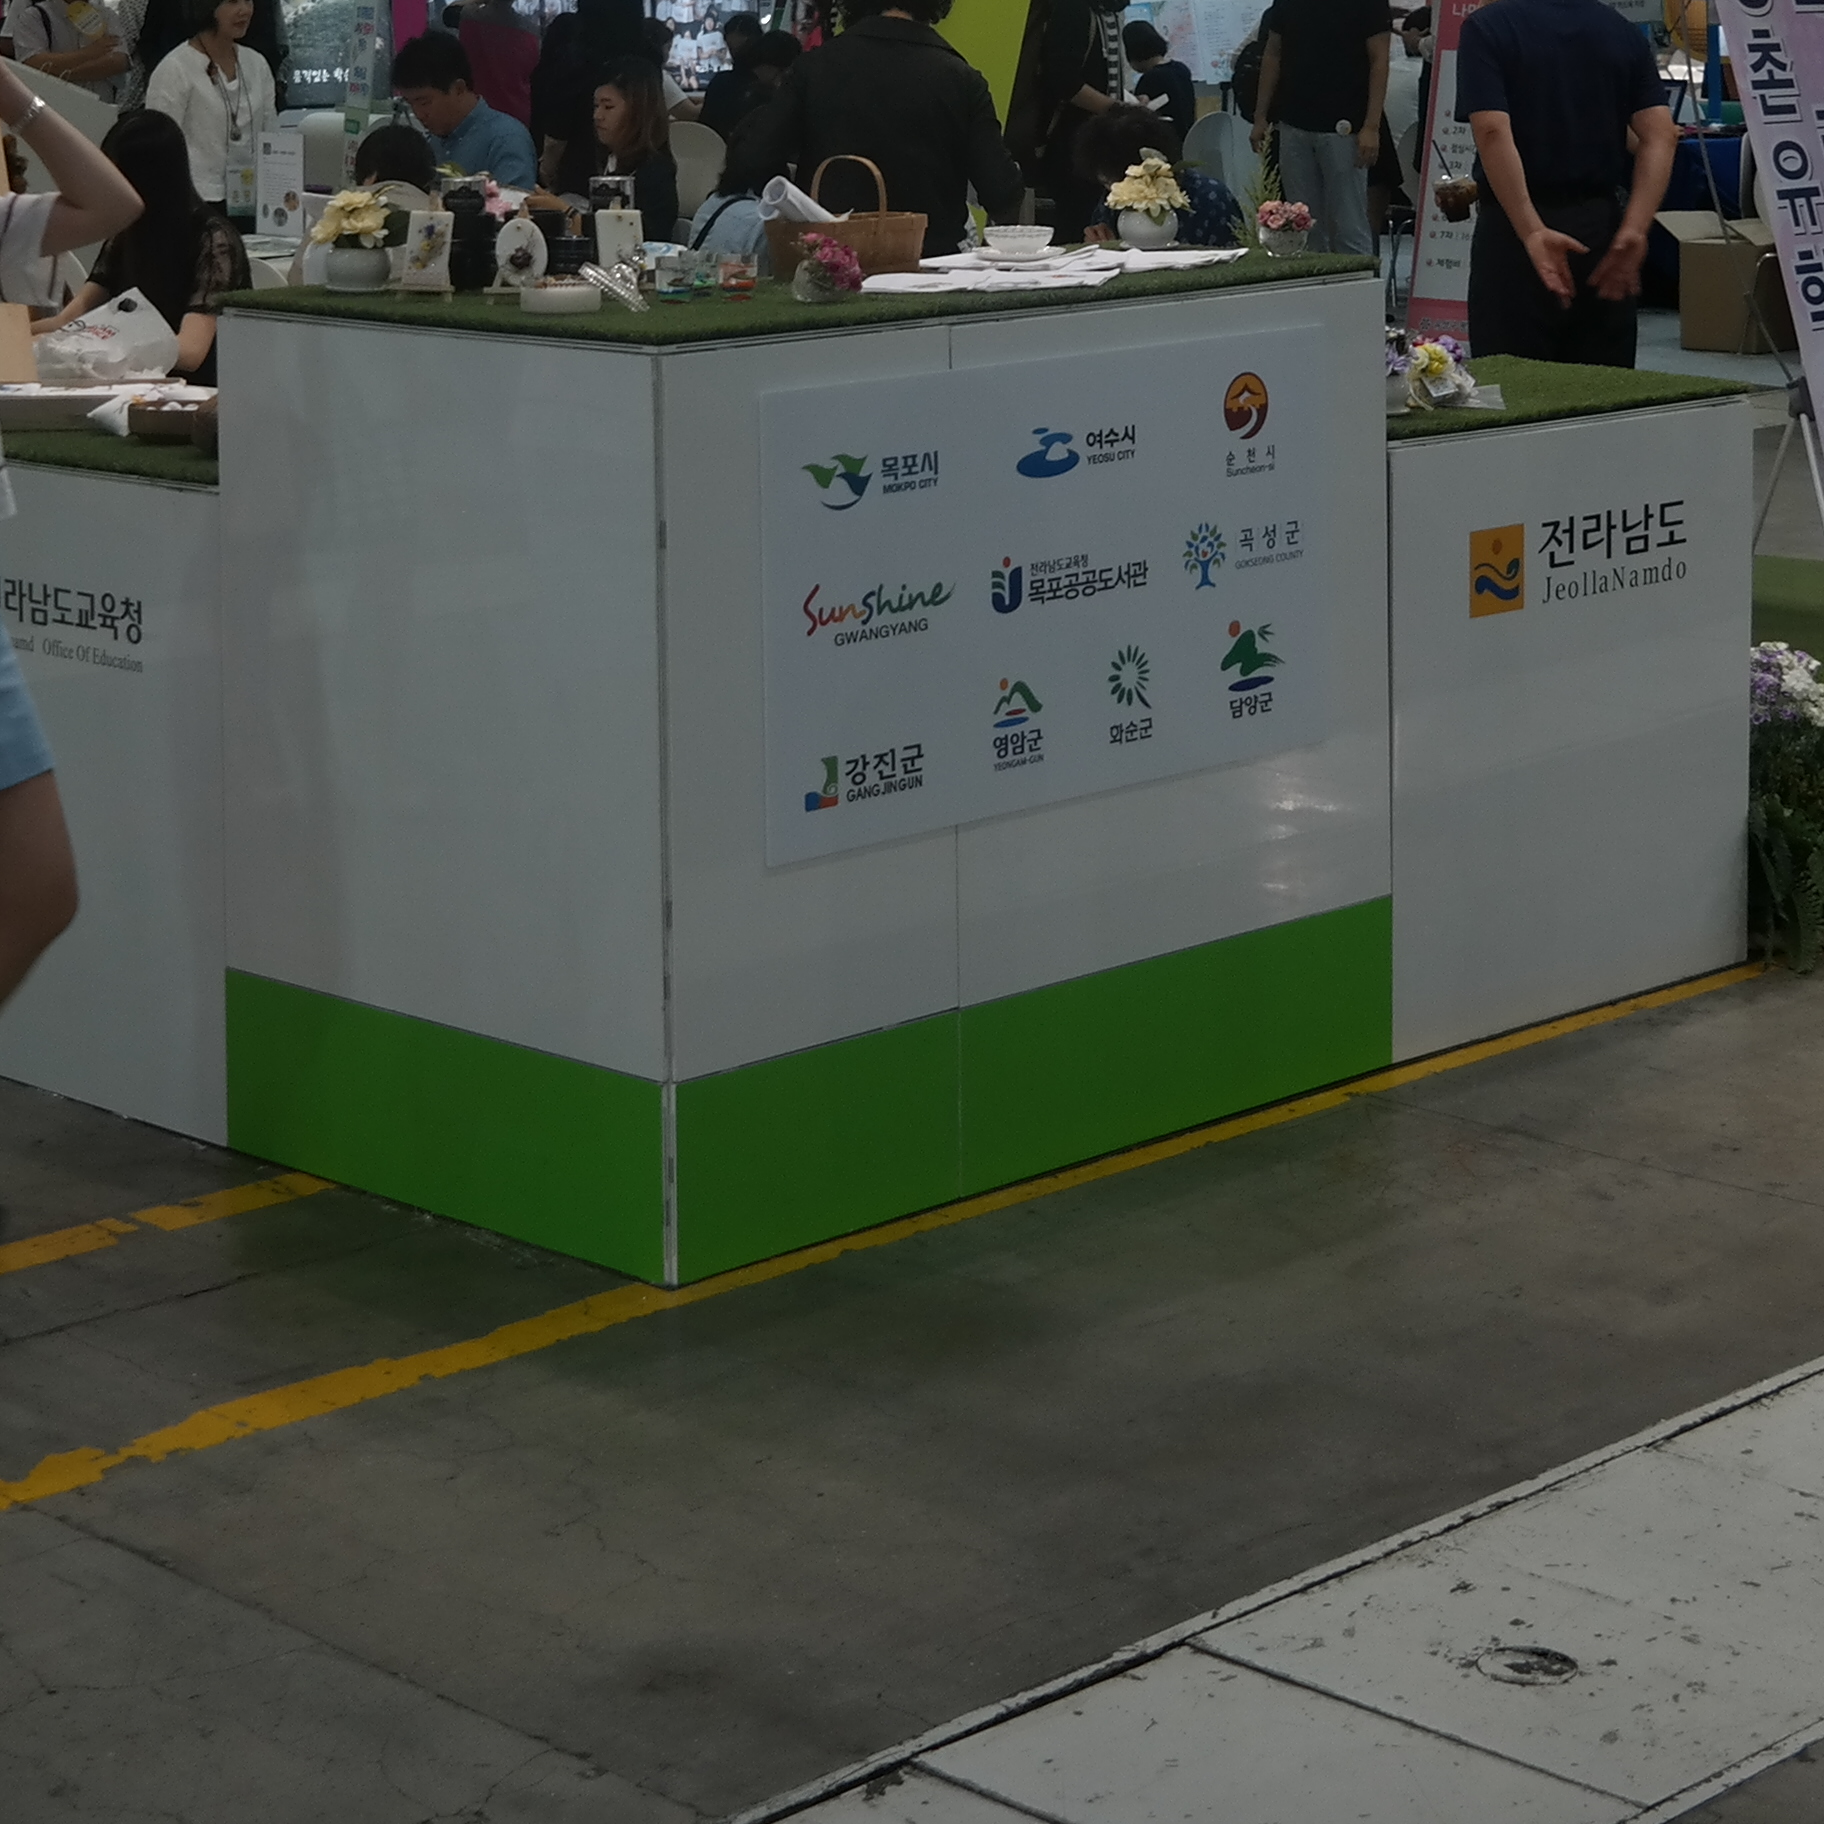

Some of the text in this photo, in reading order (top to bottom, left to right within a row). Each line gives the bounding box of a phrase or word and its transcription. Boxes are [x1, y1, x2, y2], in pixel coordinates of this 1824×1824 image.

[1085, 424, 1136, 449] 여수시
[881, 450, 940, 480] 목포시
[1086, 448, 1136, 465] YEOSU CITY
[882, 476, 939, 494] MOKPO CITY
[1238, 520, 1301, 552] 곡성군
[1538, 499, 1688, 569] 전라남도
[1030, 554, 1089, 576] 전라남도교육청
[1542, 556, 1688, 604] JeollaNamdo
[1028, 560, 1149, 604] 목포공공도서관
[802, 579, 957, 637] Sunshine
[834, 617, 929, 647] GWANGYANG
[42, 637, 75, 660] Office
[92, 647, 144, 674] Education
[1229, 692, 1275, 720] 담양군
[992, 727, 1044, 760] 영암군
[1109, 717, 1153, 746] 화순군
[845, 742, 925, 786] 강진군
